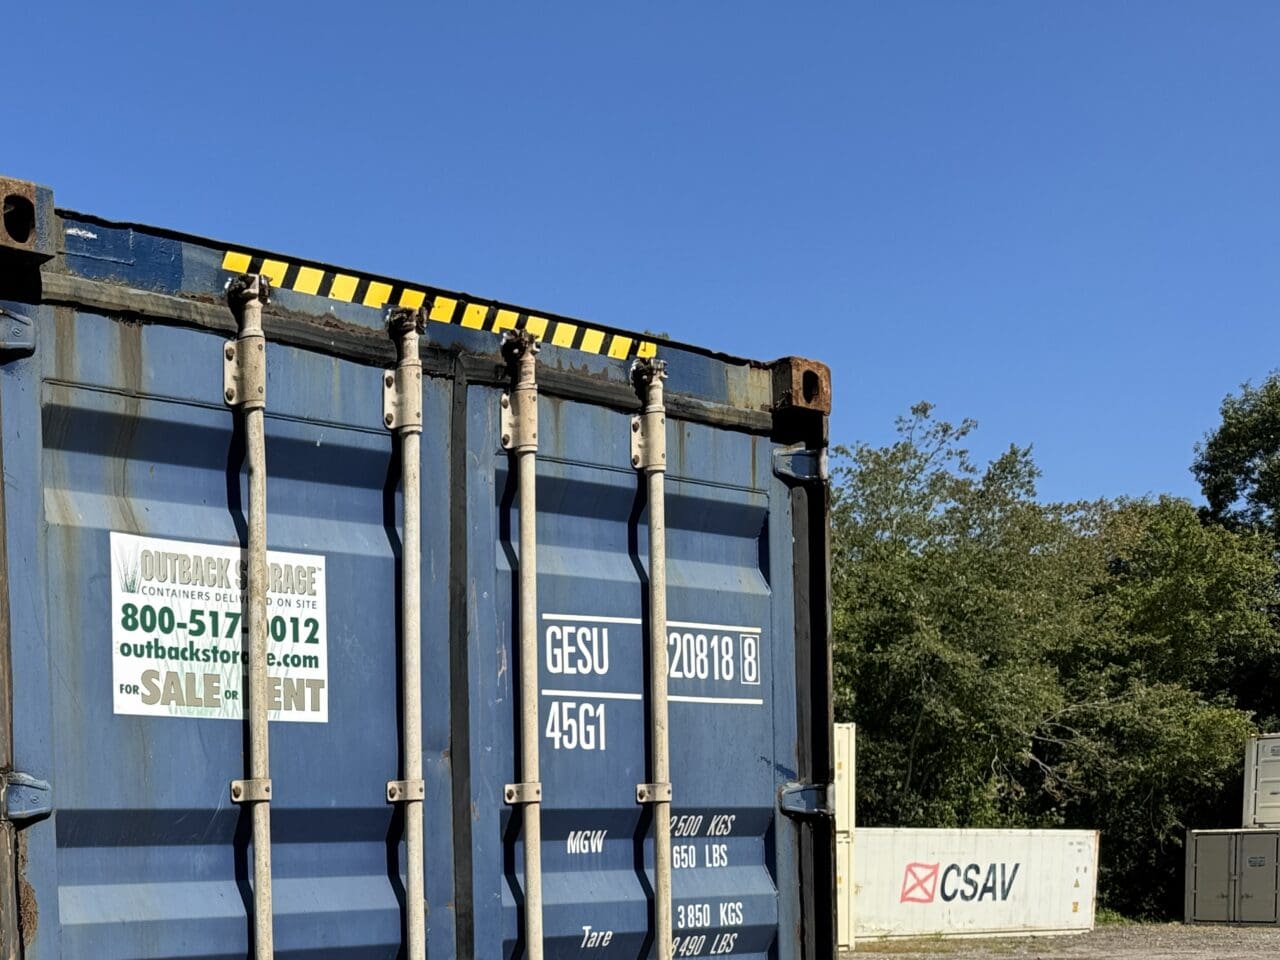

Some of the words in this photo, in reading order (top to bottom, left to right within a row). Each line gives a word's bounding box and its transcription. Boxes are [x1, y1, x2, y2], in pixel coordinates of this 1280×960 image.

[140, 549, 231, 589] OUTBACK
[234, 558, 317, 597] SRAGE
[141, 585, 210, 601] CONTAINERS
[215, 592, 273, 607] DELIVD
[277, 598, 292, 608] ON
[296, 600, 317, 610] SITE
[121, 603, 319, 644] 800-517-012
[120, 638, 319, 668] outbackstorae.com
[546, 625, 609, 675] GESU
[666, 632, 734, 681] 20818
[742, 636, 758, 683] 8
[120, 684, 139, 694] FOR
[140, 669, 220, 708] SALE
[224, 690, 238, 700] OR
[267, 676, 325, 712] ENT
[545, 701, 606, 751] 45G1
[706, 814, 736, 836] KGS
[567, 830, 607, 854] MGW
[704, 844, 728, 868] LBS
[940, 863, 1020, 902] CSAV
[720, 901, 743, 927] KGS
[580, 926, 613, 948] Tare
[710, 933, 739, 955] LBS
